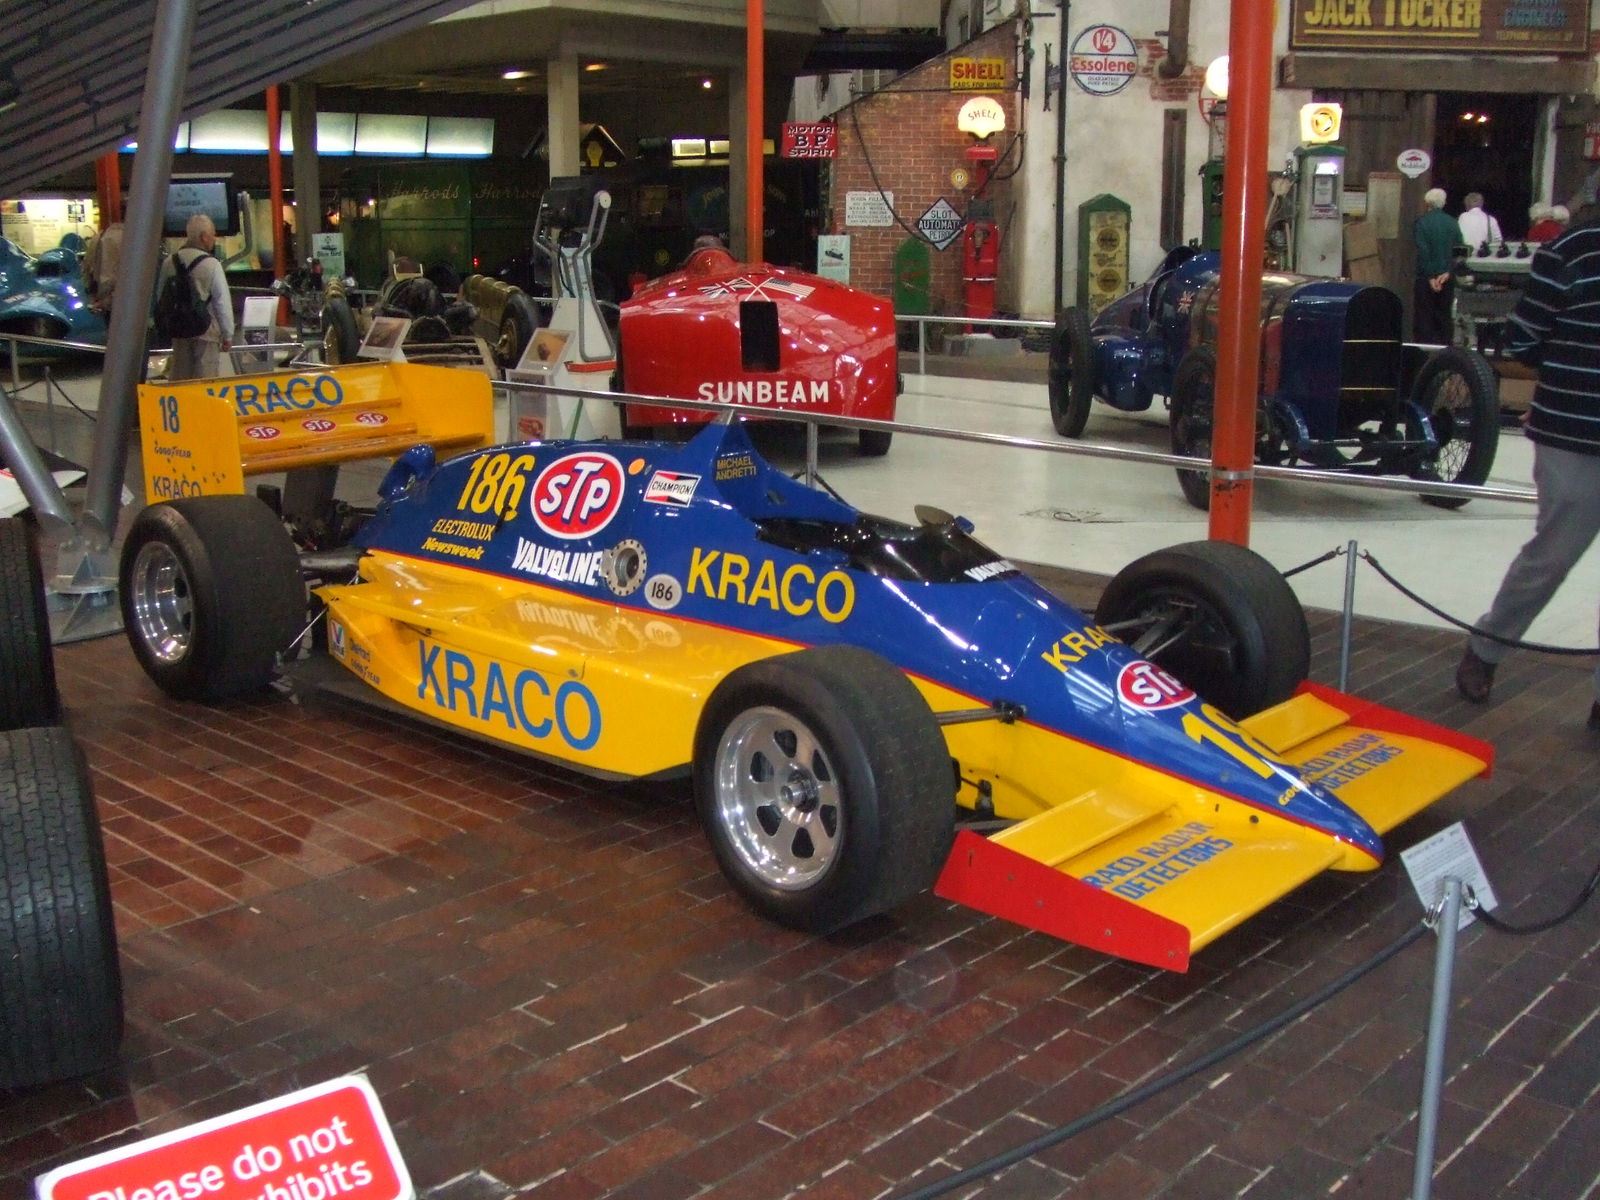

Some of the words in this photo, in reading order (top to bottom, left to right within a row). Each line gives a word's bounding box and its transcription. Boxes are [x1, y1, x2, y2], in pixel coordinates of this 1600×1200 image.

[1304, 0, 1372, 27] JACK
[1384, 0, 1482, 28] TUCKER
[953, 63, 1004, 80] SHELL
[1072, 56, 1136, 73] Essolene
[968, 109, 997, 121] SHELL
[788, 126, 834, 135] MOTOR
[788, 149, 835, 157] SPIRIT
[930, 210, 954, 219] SLOT
[930, 231, 951, 240] PETRO
[698, 381, 829, 403] SUNBEAM
[158, 395, 180, 433] 18
[360, 412, 385, 424] STP
[249, 427, 277, 438] STP
[305, 420, 332, 431] STP
[716, 466, 757, 481] ANDRETTI
[717, 456, 753, 470] MICHAEL
[152, 475, 202, 499] KRACO
[457, 453, 535, 521] 186
[539, 460, 611, 522] STP
[651, 480, 693, 495] CHAMPION
[432, 518, 496, 541] ELECTROLUX
[421, 537, 486, 560] Newsweek
[511, 536, 602, 586] VALVOLINE
[651, 581, 673, 601] 186
[686, 547, 856, 624] KRACO
[418, 639, 602, 751] KRACO
[1132, 664, 1187, 705] STP
[1080, 856, 1147, 889] RACO
[1136, 821, 1215, 858] RADAR
[1111, 836, 1234, 900] DETECTORS
[232, 1144, 283, 1181] do
[288, 1115, 354, 1163] not
[246, 1160, 373, 1200] hibits
